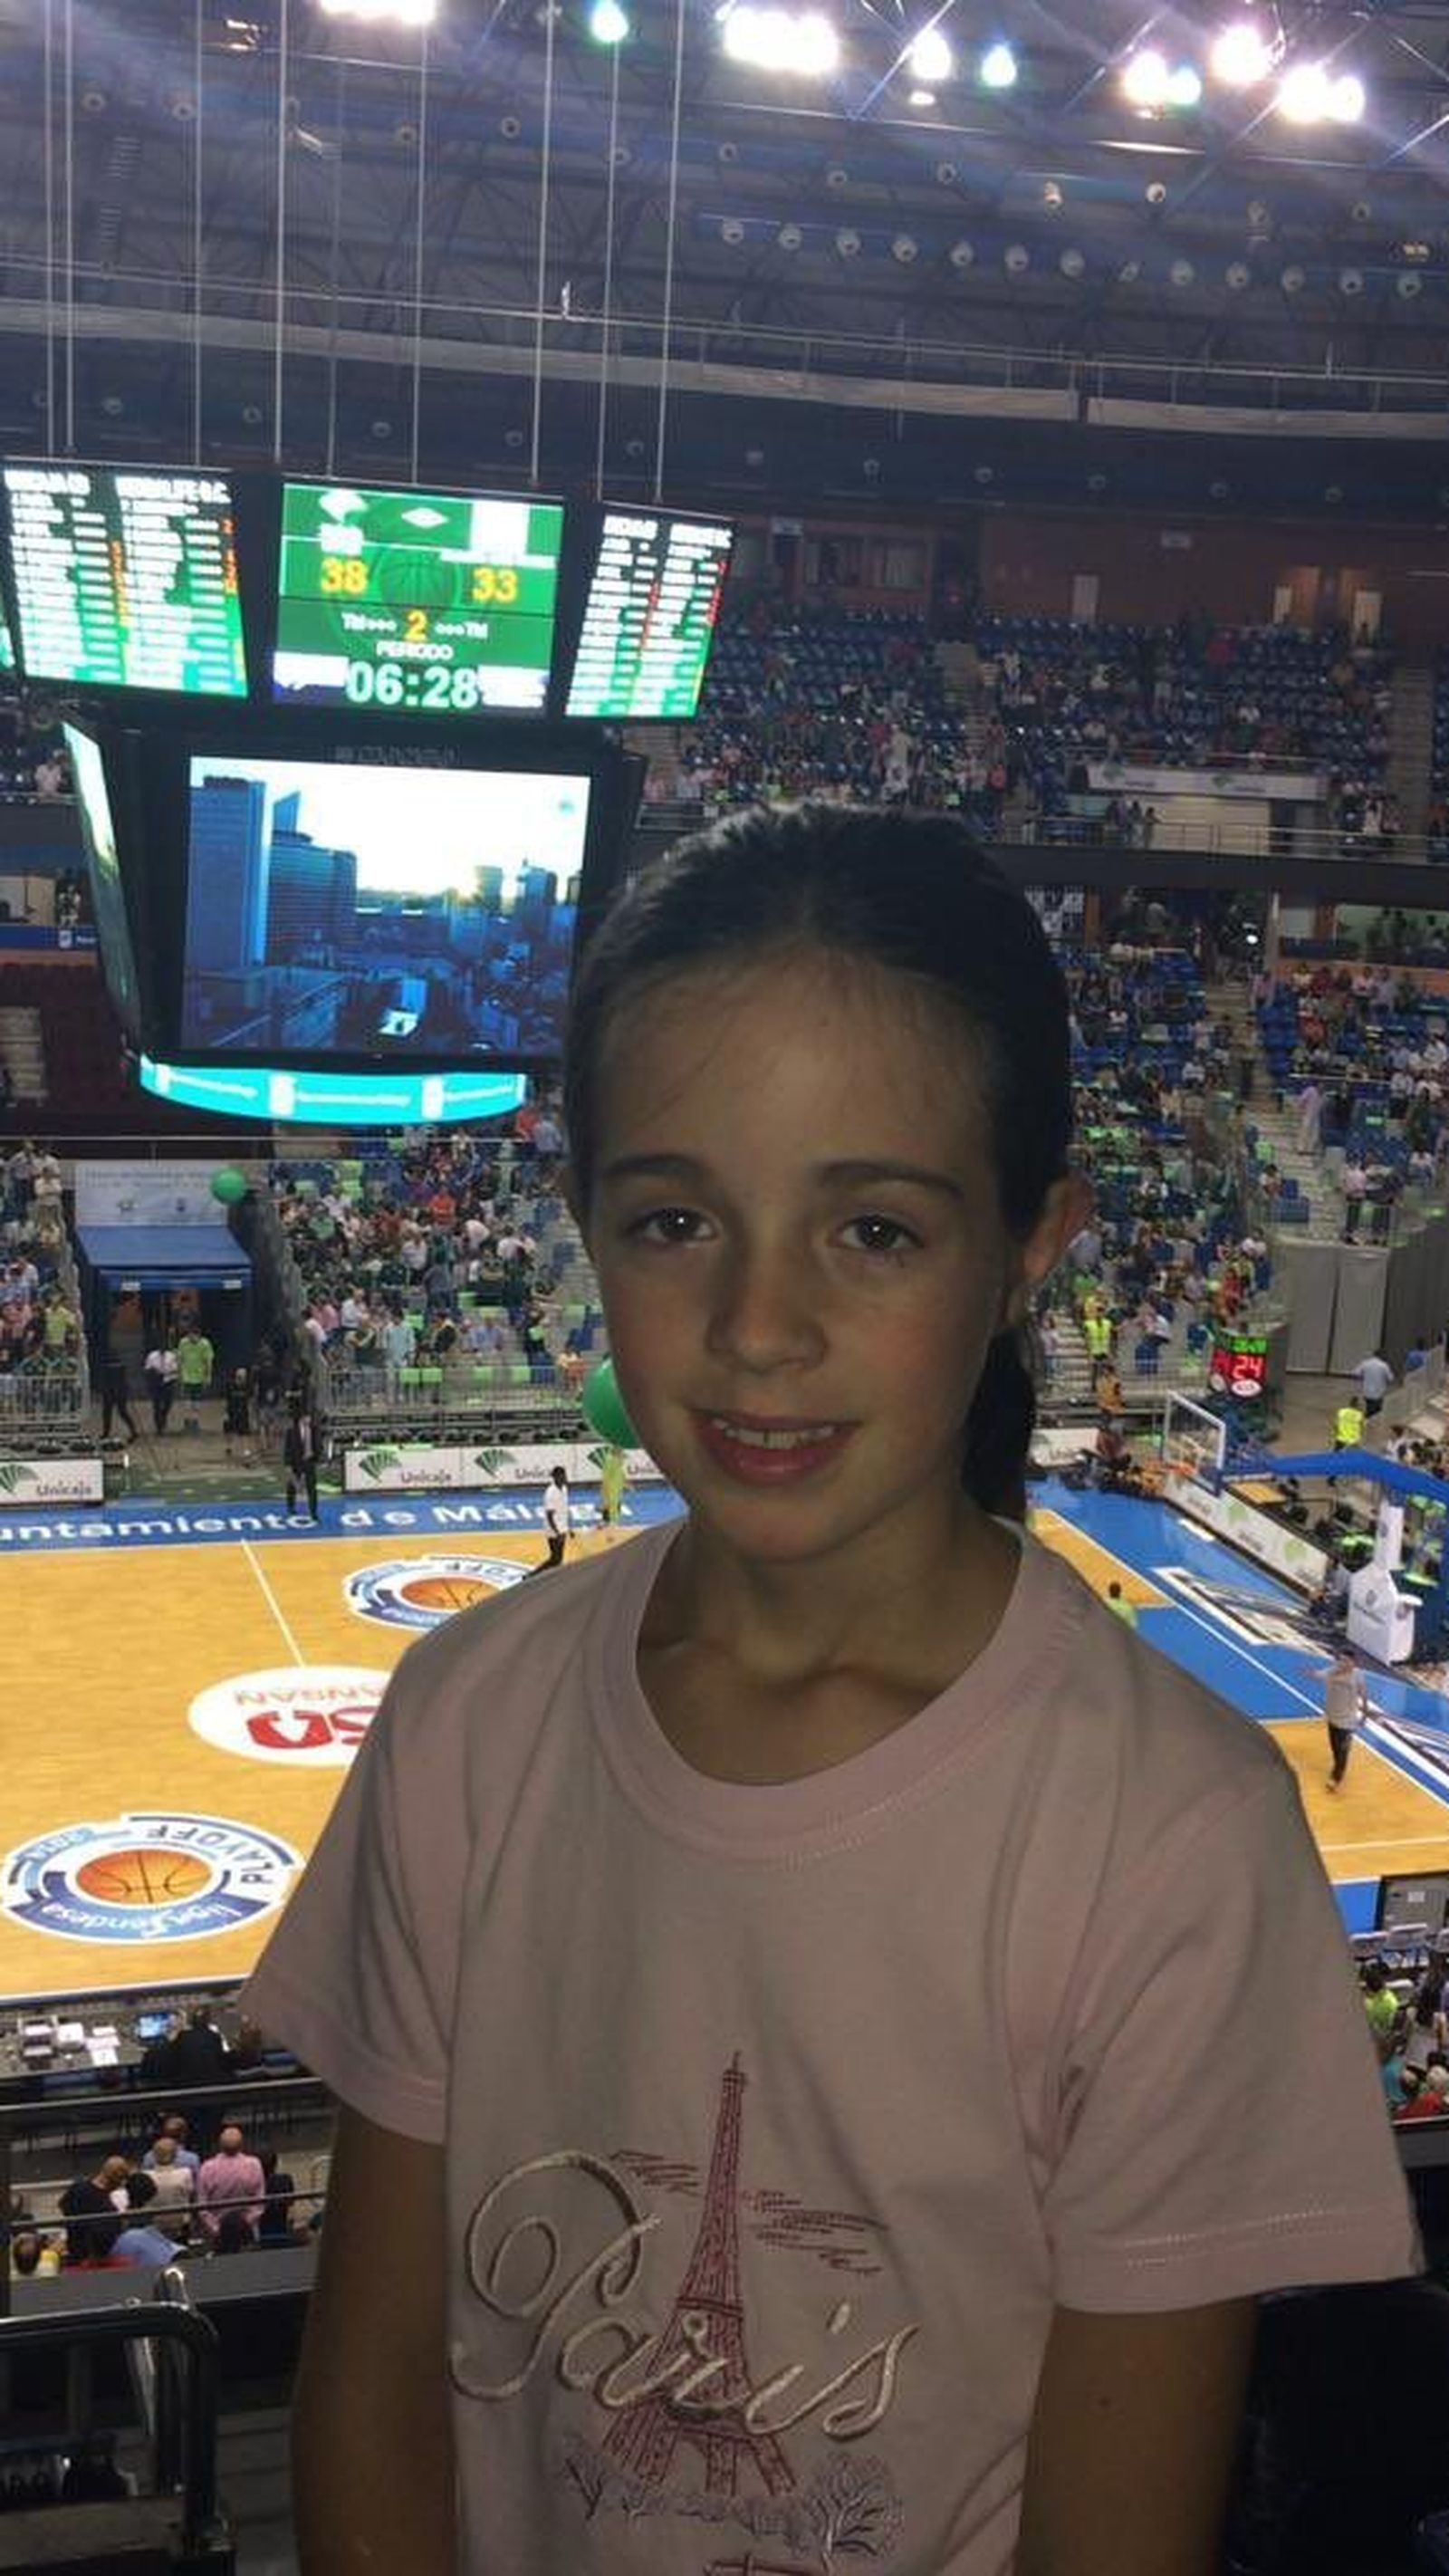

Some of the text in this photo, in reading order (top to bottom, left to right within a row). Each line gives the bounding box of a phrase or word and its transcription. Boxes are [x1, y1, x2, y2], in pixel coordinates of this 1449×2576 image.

[321, 557, 368, 593] 38
[472, 567, 518, 603] 33
[404, 610, 427, 641] 2
[344, 661, 479, 708] 06:28
[1233, 1355, 1263, 1380] 24
[341, 1509, 417, 1527] de
[146, 1823, 274, 1885] PLAYOFF
[450, 2149, 919, 2442] Paris
